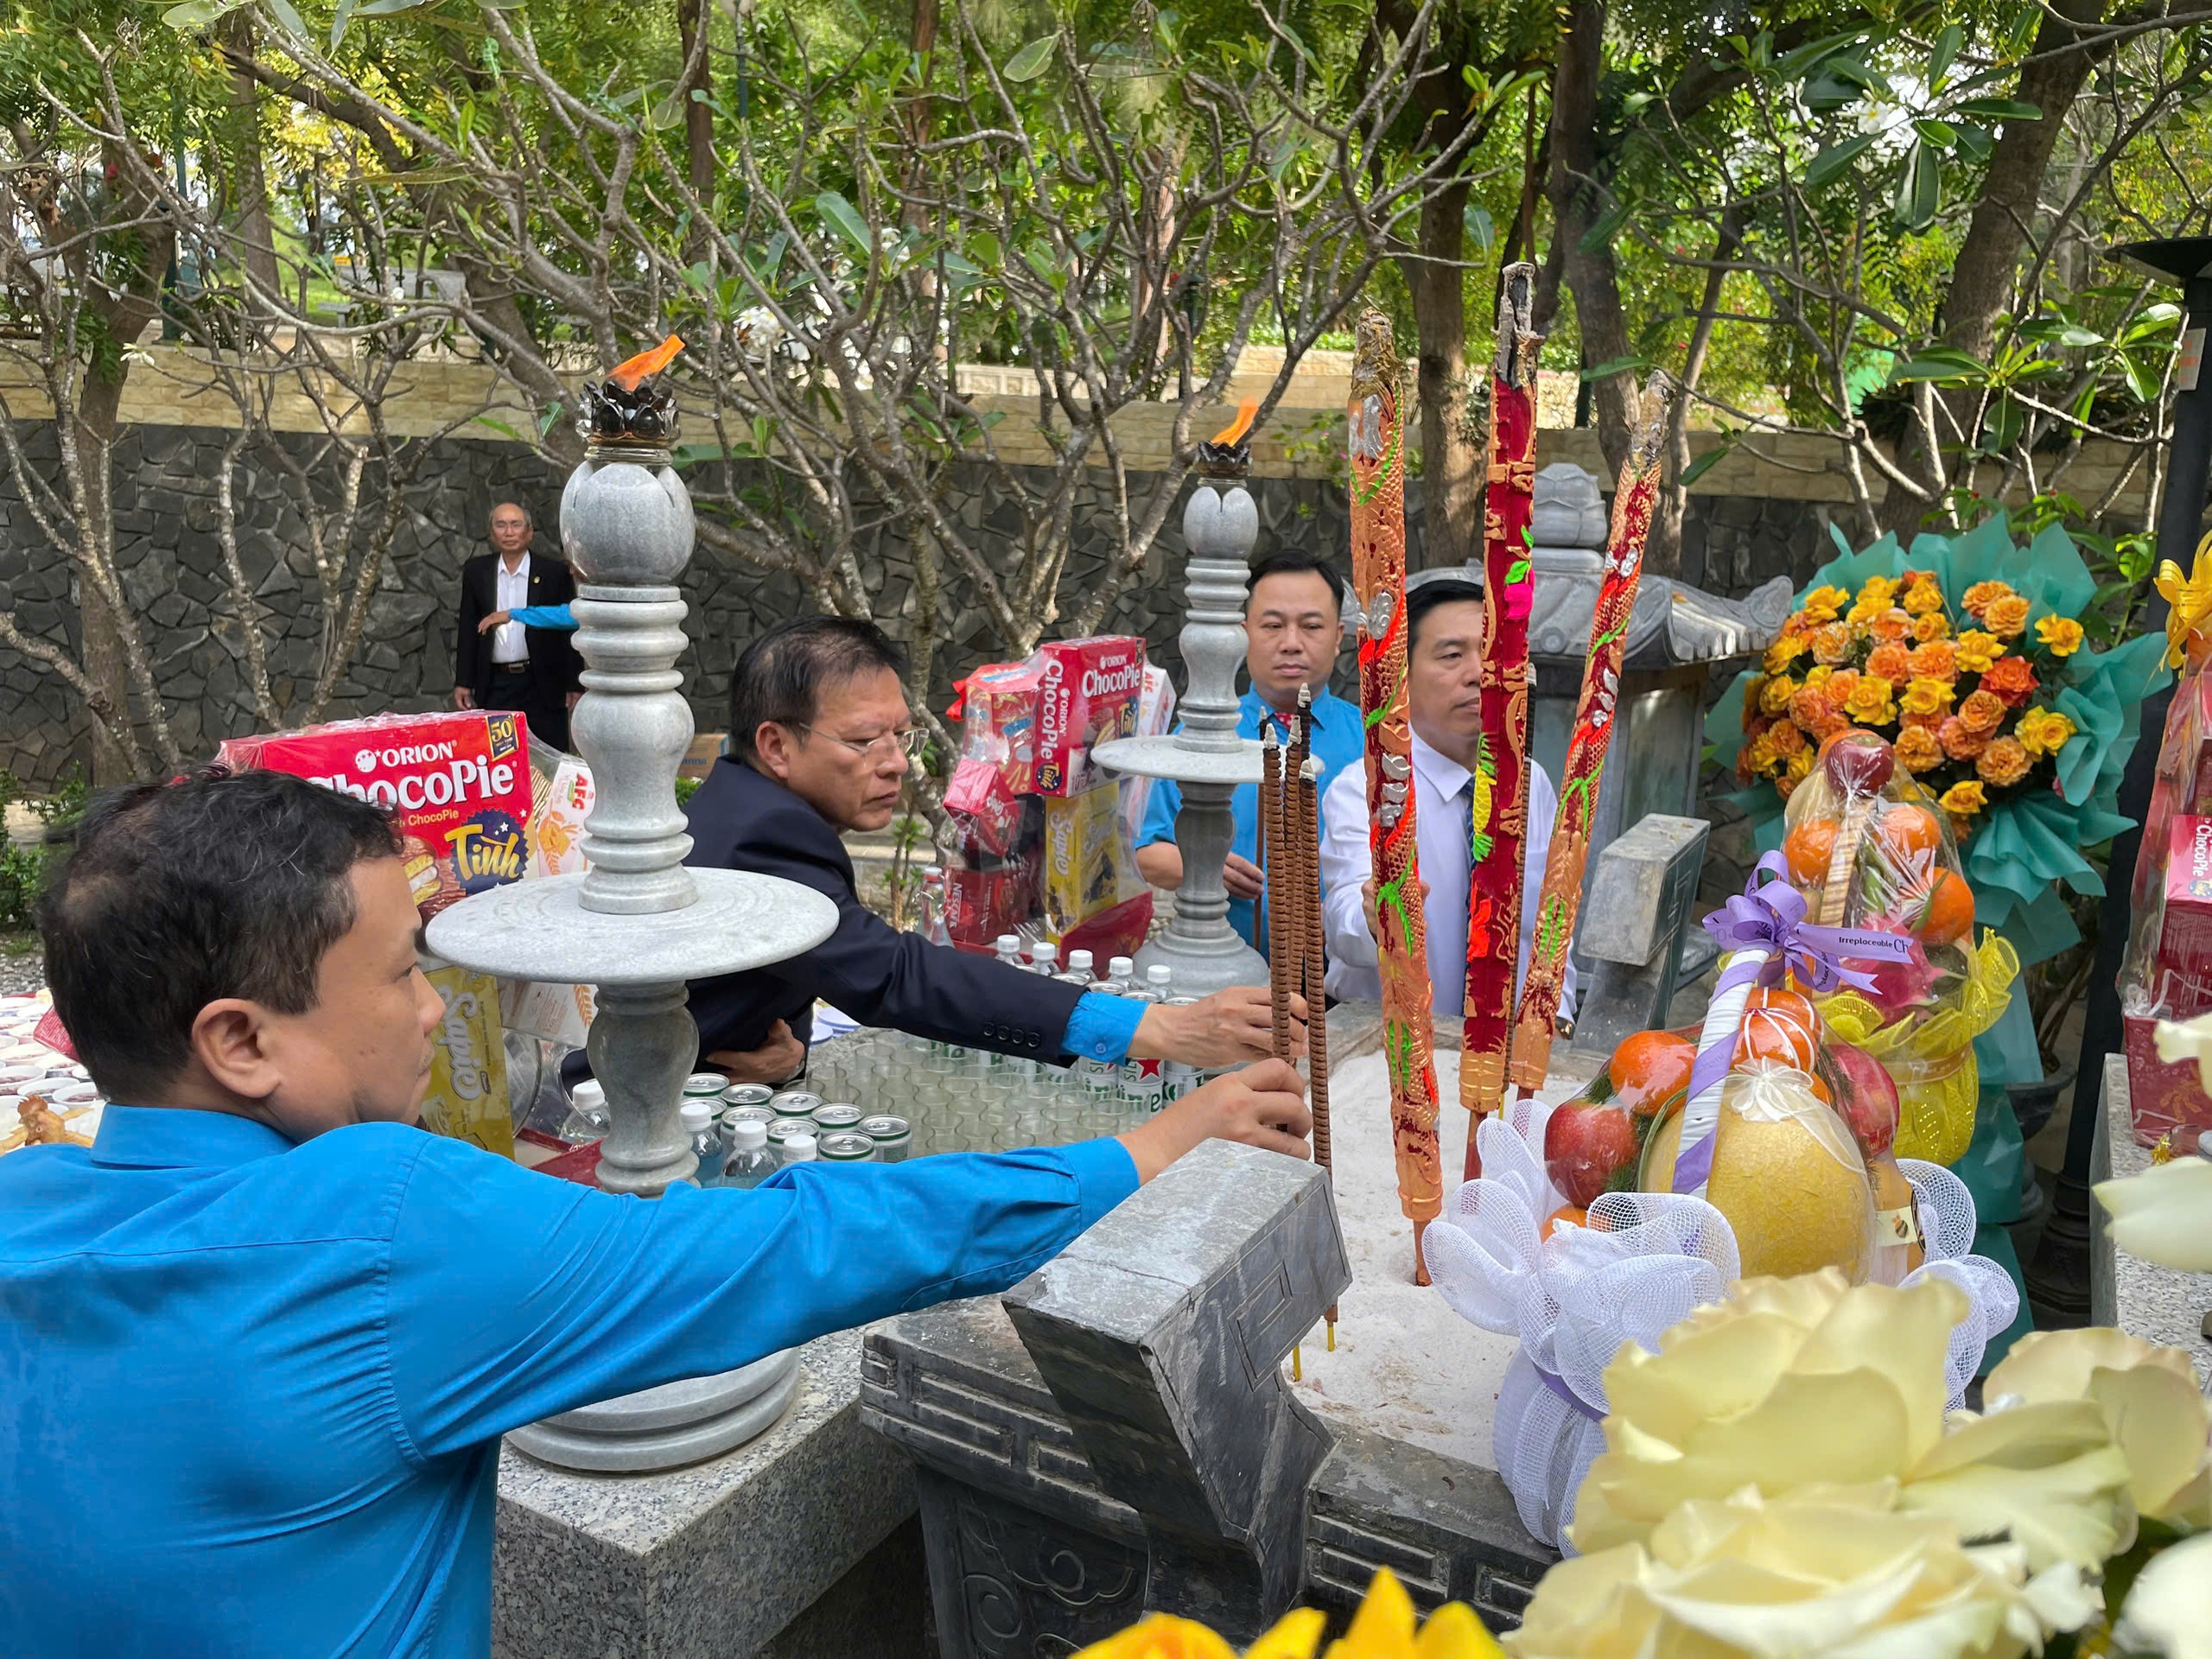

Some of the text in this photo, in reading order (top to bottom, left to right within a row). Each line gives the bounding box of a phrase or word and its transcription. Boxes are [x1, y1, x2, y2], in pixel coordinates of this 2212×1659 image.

[1082, 663, 1141, 698] ChocoPie
[1041, 658, 1064, 760] ChocoPie
[1059, 702, 1069, 734] ORION
[491, 718, 512, 743] 50
[381, 742, 454, 768] ORION
[308, 754, 514, 810] hocoPie
[572, 773, 588, 810] AFC
[408, 808, 460, 827] ChocoPie
[2192, 824, 2212, 877] ChocoPie
[1839, 937, 1893, 948] Irreplaceable
